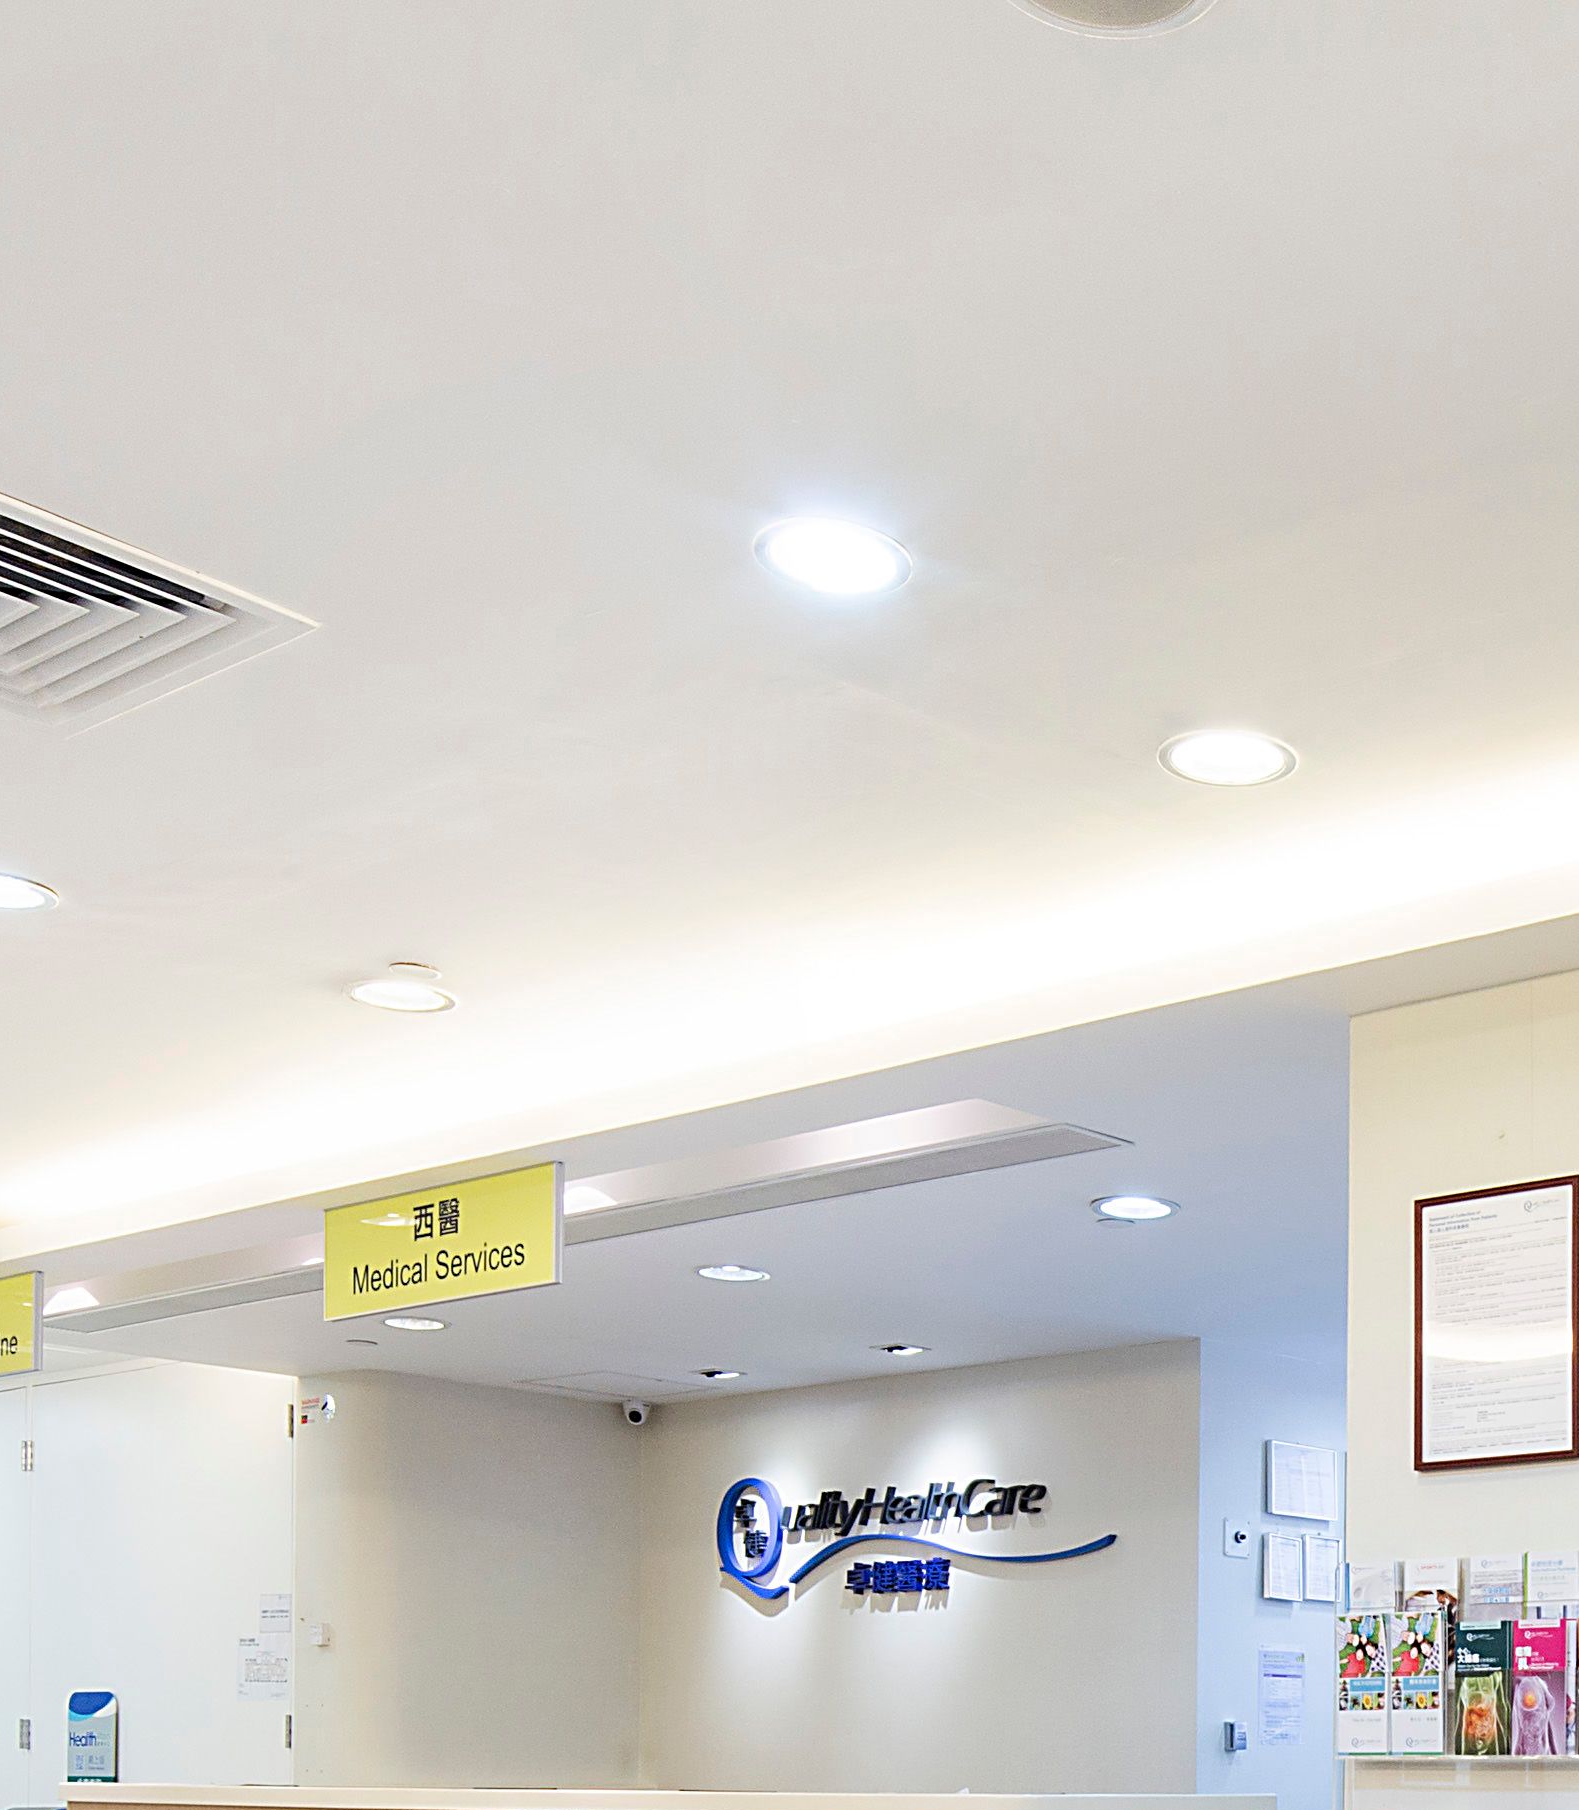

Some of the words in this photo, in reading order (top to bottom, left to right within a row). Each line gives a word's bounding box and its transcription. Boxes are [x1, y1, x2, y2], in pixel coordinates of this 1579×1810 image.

[412, 1198, 461, 1242] 西醫
[351, 1251, 428, 1296] Medical
[434, 1238, 526, 1282] Services
[69, 1732, 97, 1748] Health
